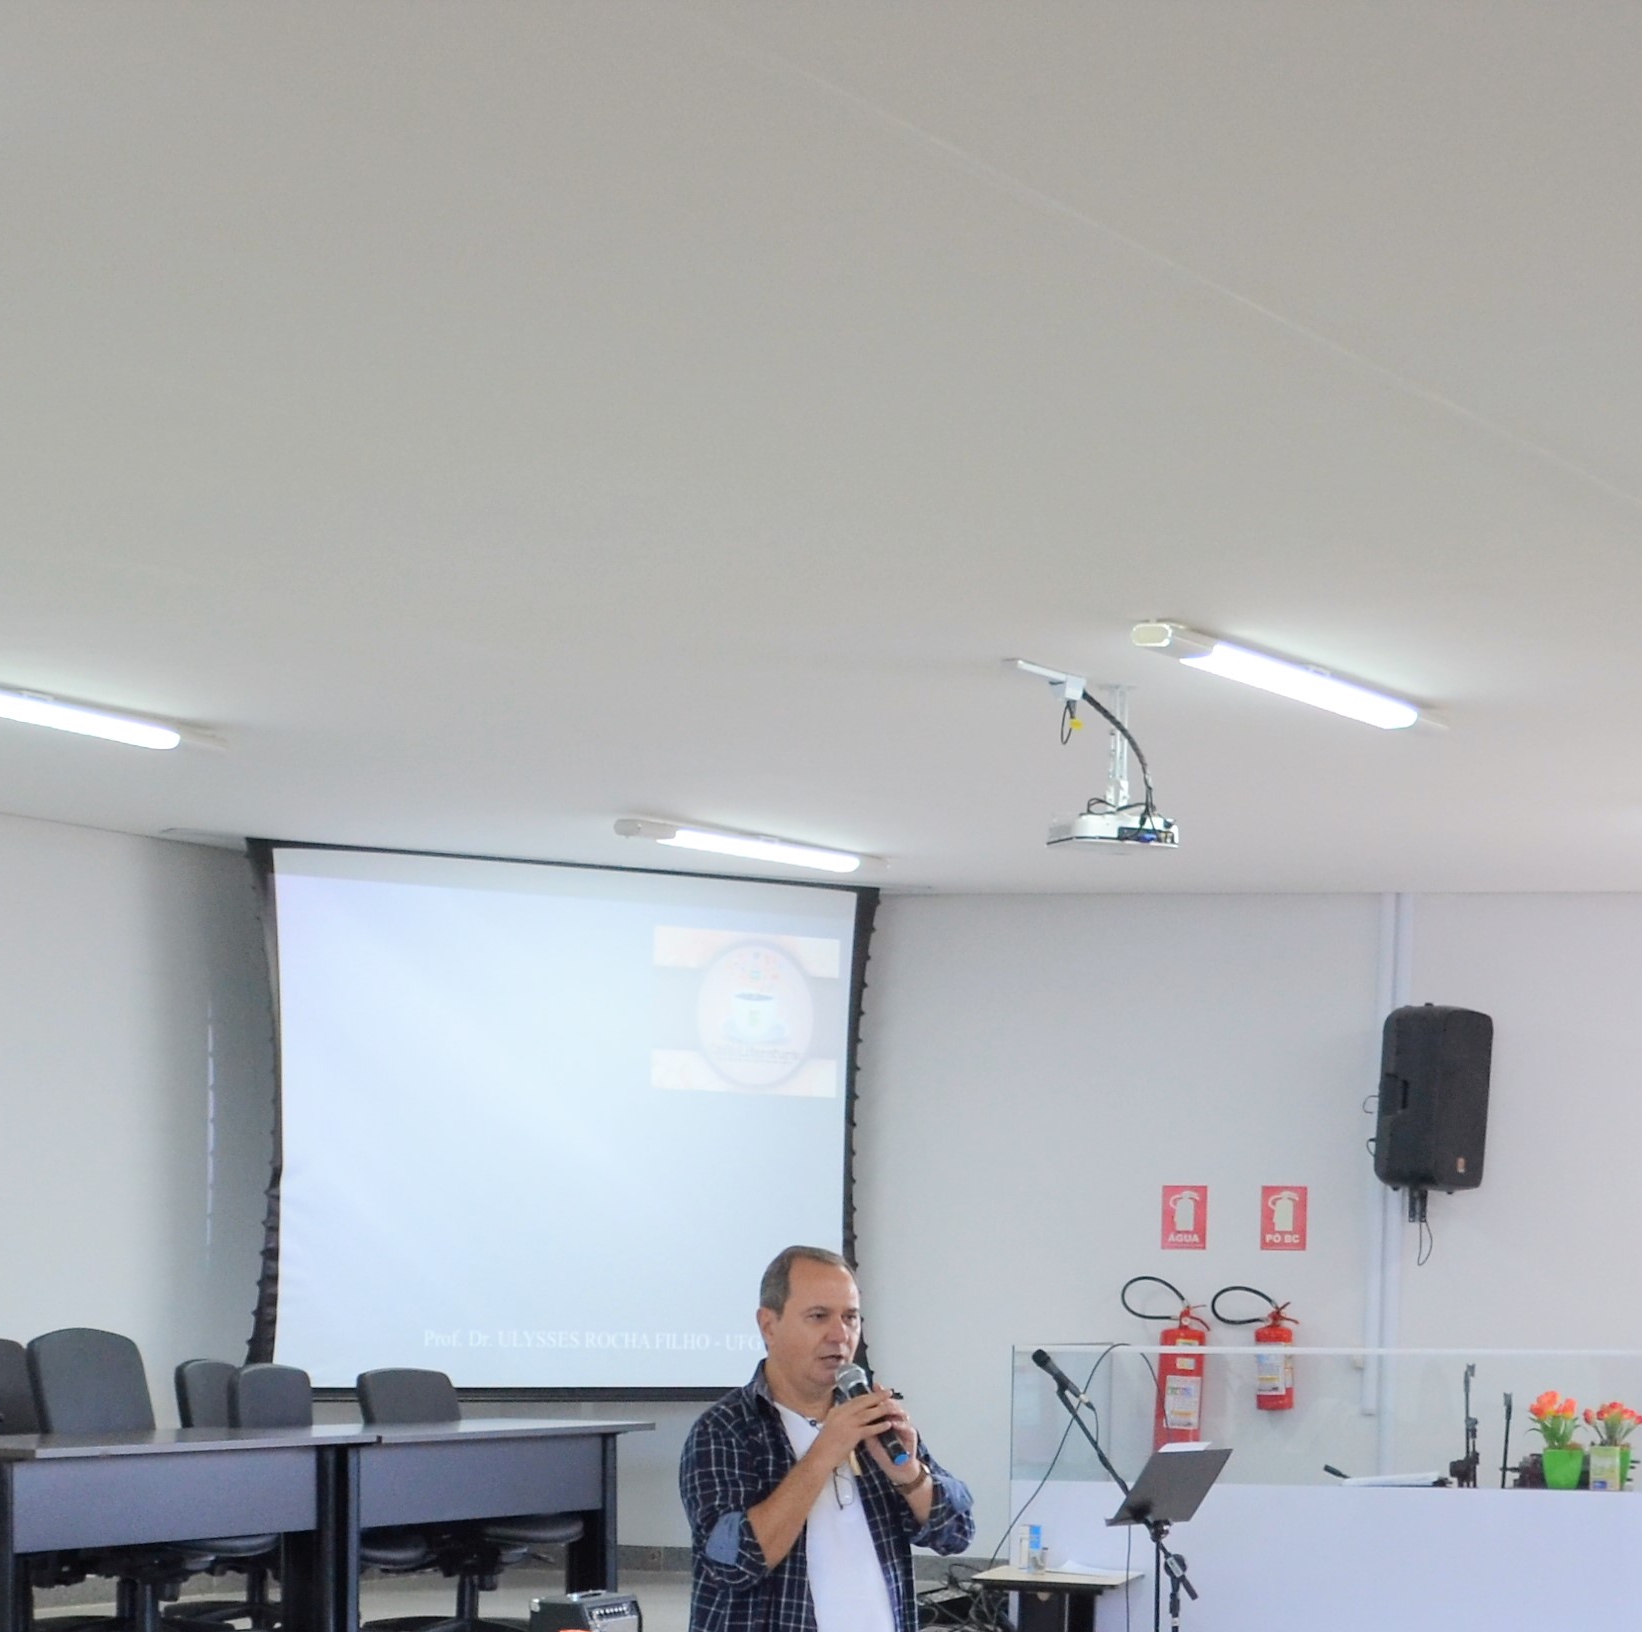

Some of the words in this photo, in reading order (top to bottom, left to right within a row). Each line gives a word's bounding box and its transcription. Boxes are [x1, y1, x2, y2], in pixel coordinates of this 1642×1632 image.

[1284, 1233, 1301, 1244] BC
[423, 1329, 463, 1348] Prof.
[468, 1330, 494, 1348] Dr.
[497, 1330, 580, 1349] ULYSSES
[585, 1332, 655, 1350] ROCHA
[655, 1332, 711, 1351] FILHO
